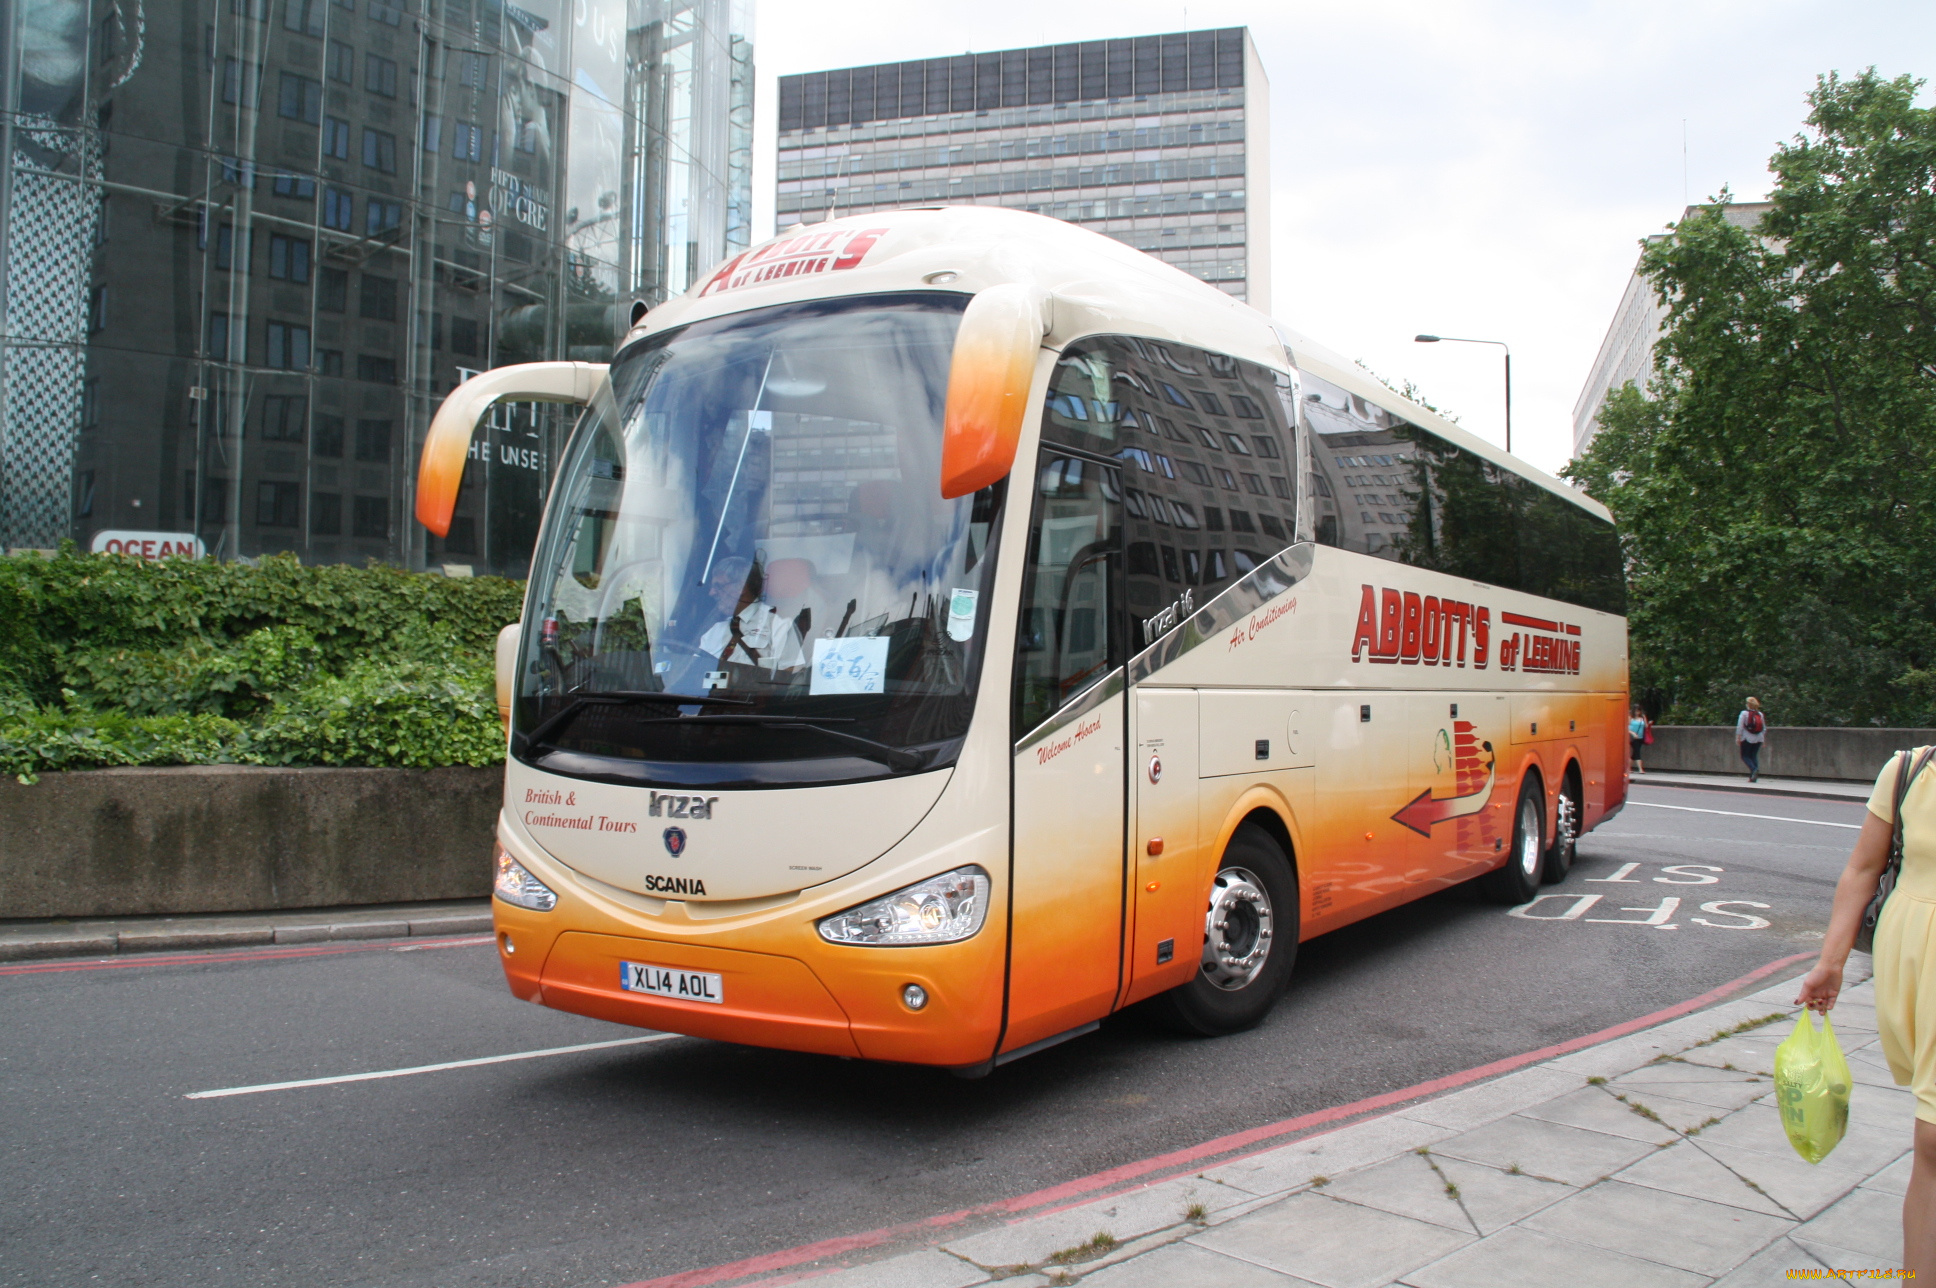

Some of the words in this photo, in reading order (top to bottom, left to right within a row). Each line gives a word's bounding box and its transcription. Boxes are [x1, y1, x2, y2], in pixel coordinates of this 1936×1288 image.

[105, 539, 194, 560] OCEAN
[1228, 627, 1245, 652] Air
[1249, 597, 1297, 641] Conditioning
[1351, 584, 1490, 669] ABBOTT'S
[1500, 632, 1520, 671] of
[1522, 631, 1581, 675] LEEMING
[1037, 737, 1072, 765] Welcome
[1074, 713, 1102, 746] Aboard
[525, 788, 562, 805] British
[565, 791, 576, 806] &
[525, 810, 594, 830] Continental
[598, 816, 638, 834] Tours
[645, 874, 707, 896] SCANIA
[634, 966, 673, 992] XL14
[679, 973, 715, 998] AOL
